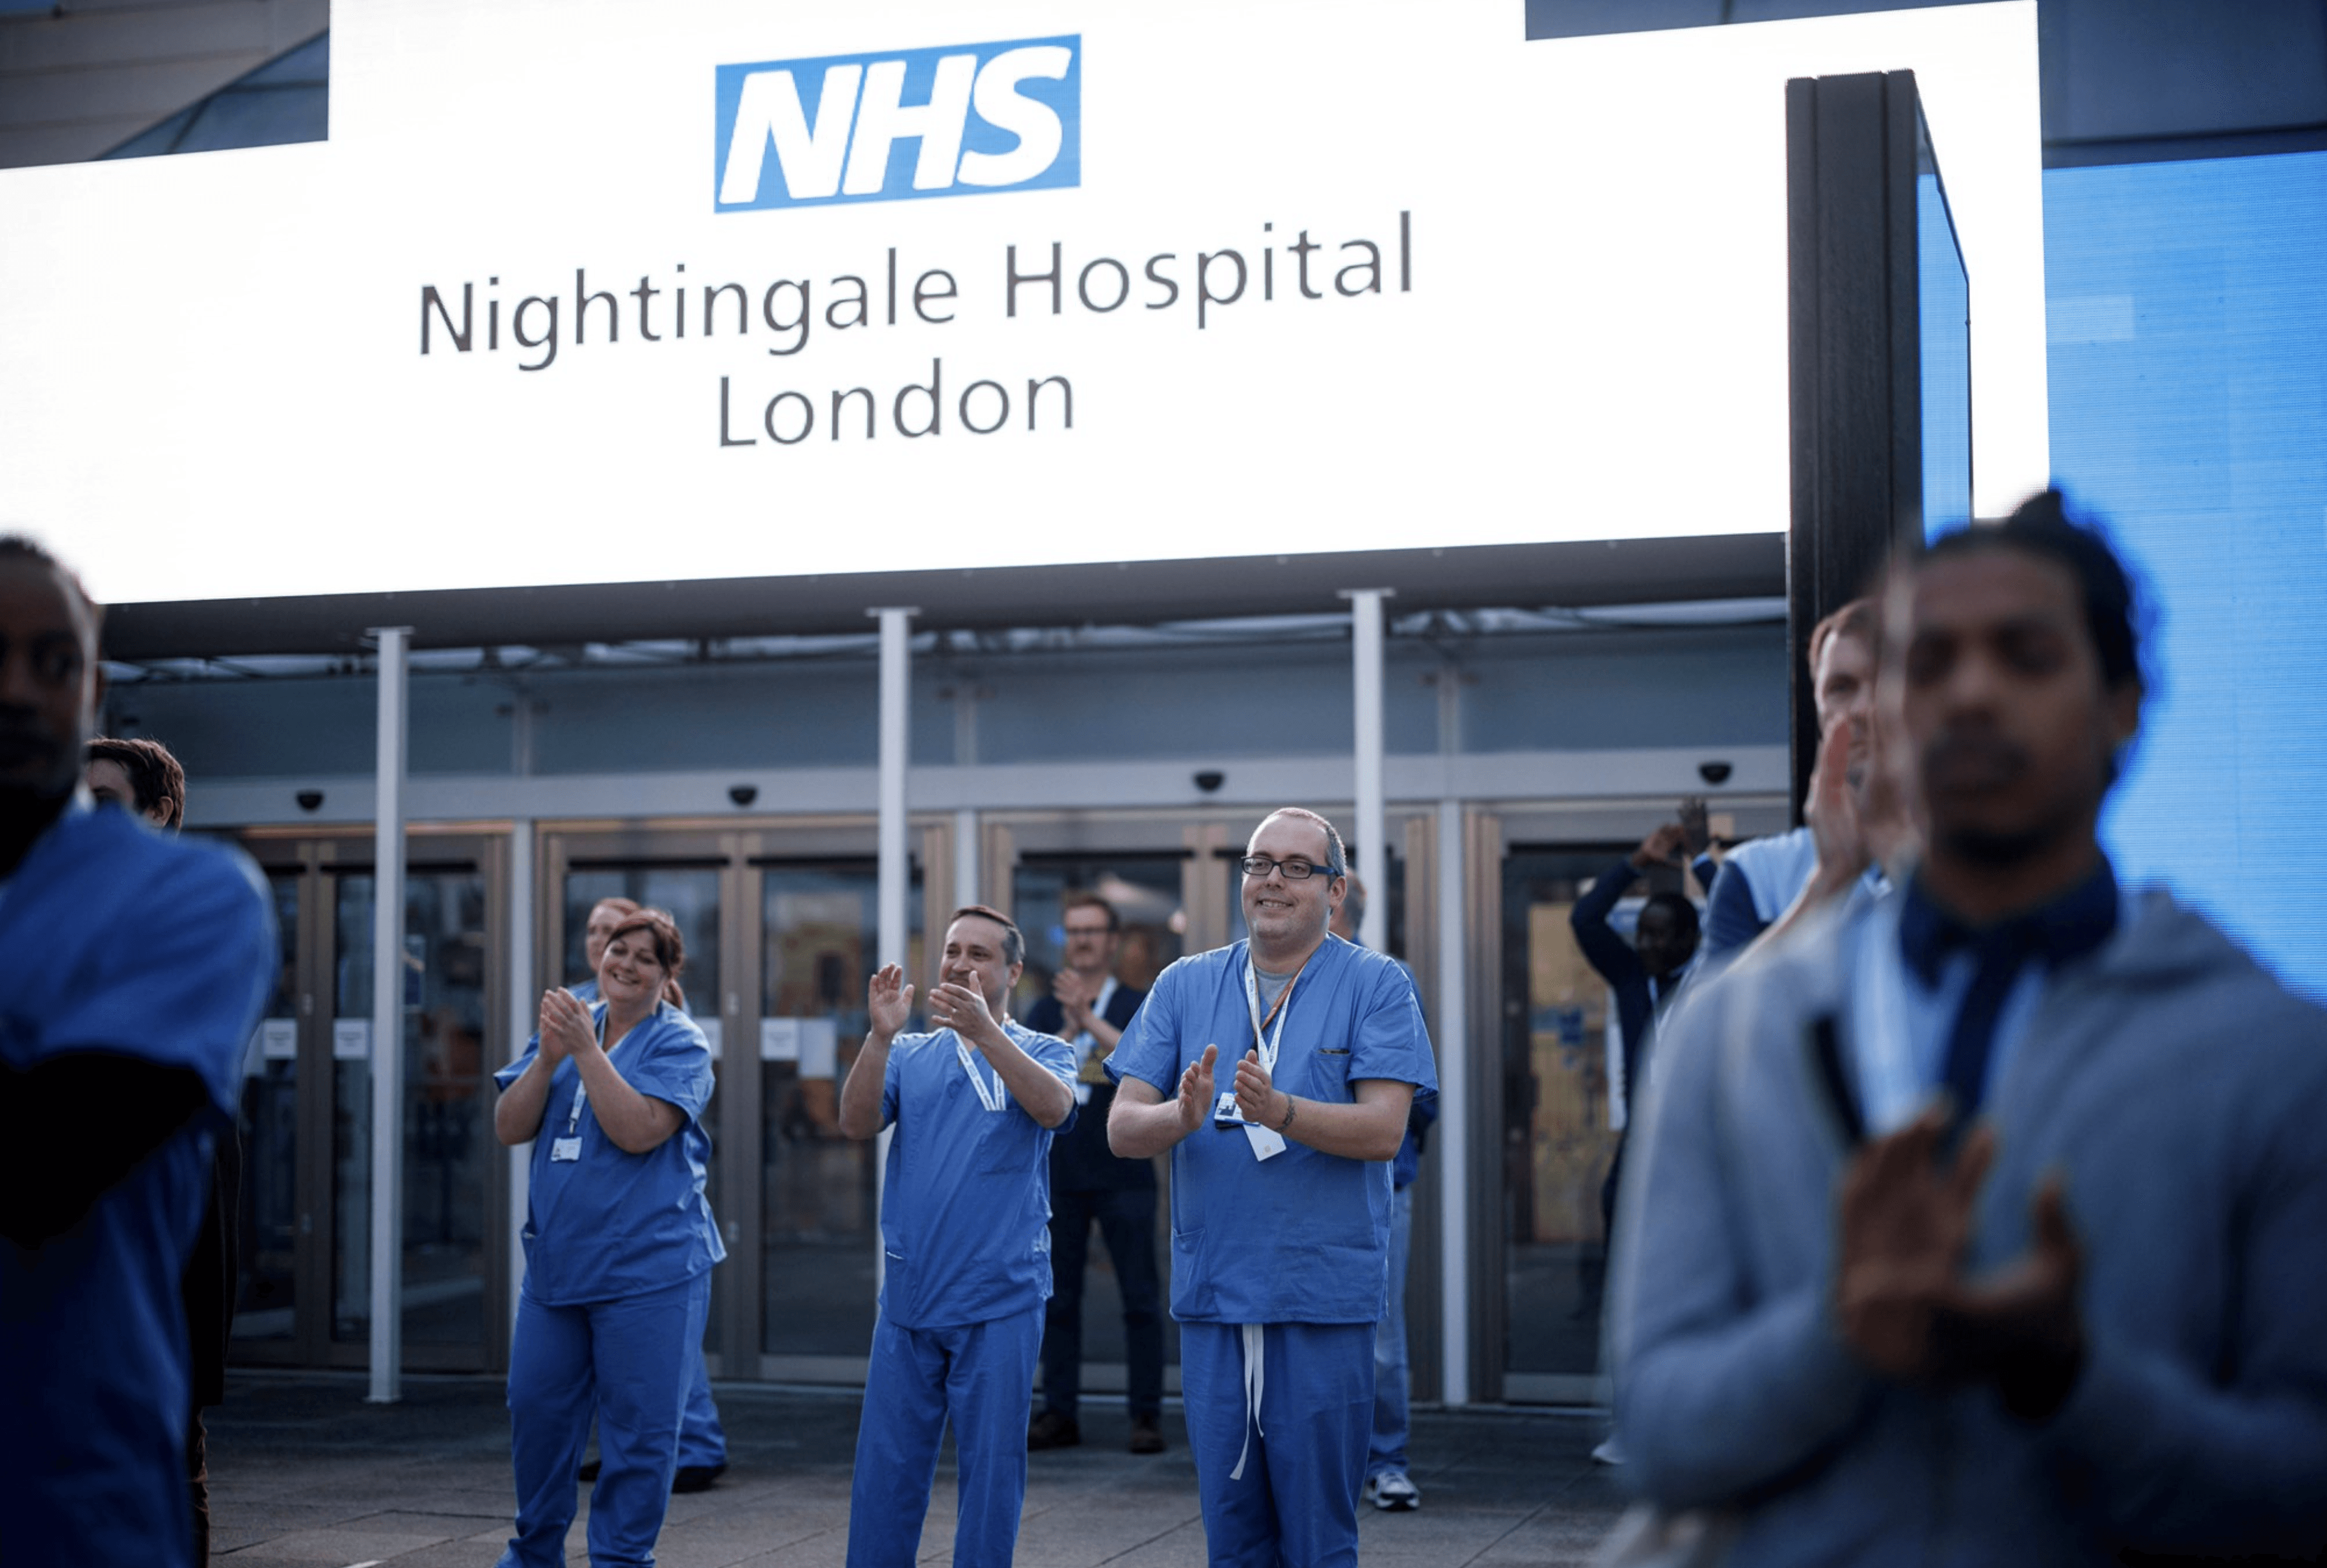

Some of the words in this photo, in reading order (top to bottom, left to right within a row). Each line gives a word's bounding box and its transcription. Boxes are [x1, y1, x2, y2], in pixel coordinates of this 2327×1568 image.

[719, 46, 1072, 205] NHS
[420, 247, 958, 372] Nightingale
[1006, 210, 1411, 330] Hospital
[720, 357, 1072, 447] London
